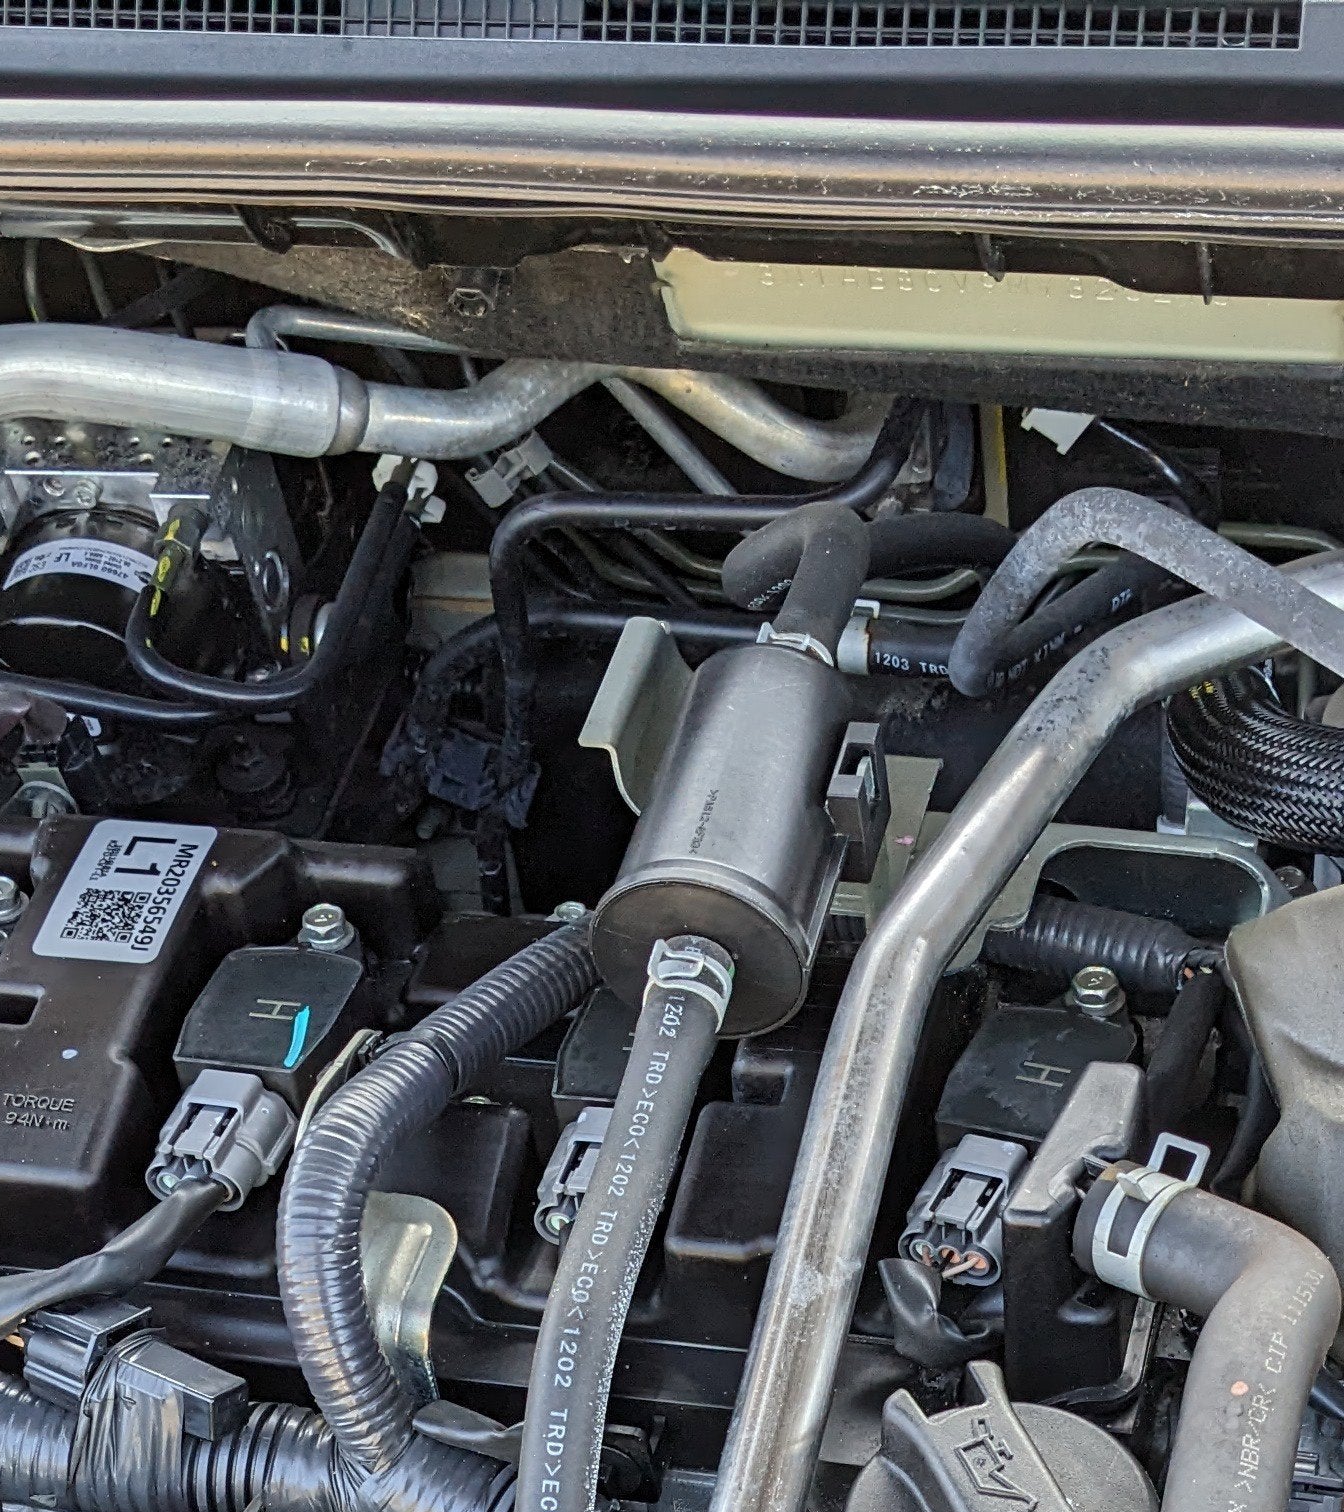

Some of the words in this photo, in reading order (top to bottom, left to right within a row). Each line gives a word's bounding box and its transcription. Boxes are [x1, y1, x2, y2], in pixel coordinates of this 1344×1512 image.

[875, 652, 910, 671] 1203
[114, 836, 177, 878] L1
[250, 999, 301, 1020] H
[659, 995, 683, 1039] 1202
[1016, 1060, 1070, 1087] H
[4, 1094, 75, 1114] TORQUE
